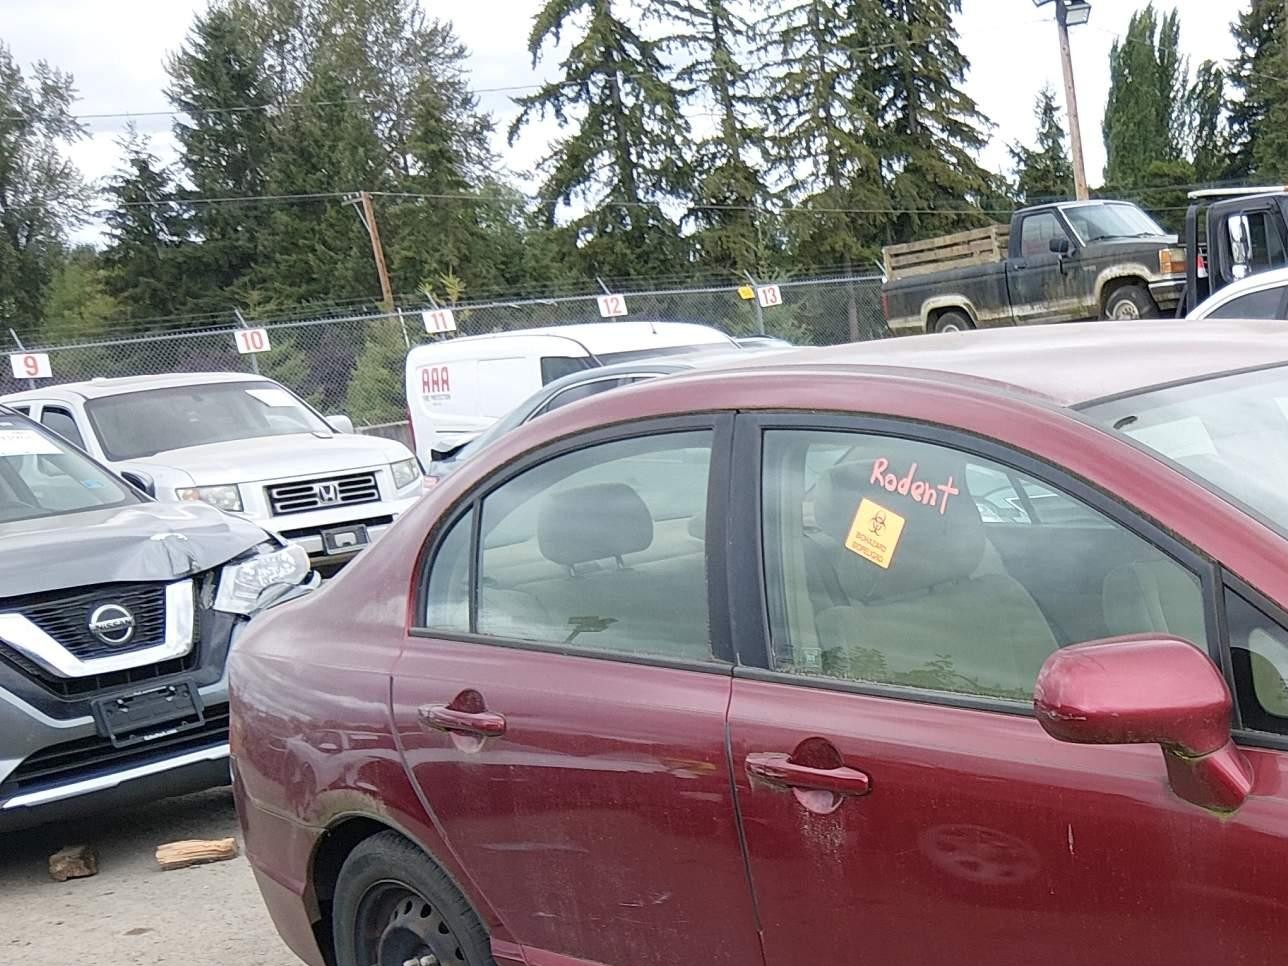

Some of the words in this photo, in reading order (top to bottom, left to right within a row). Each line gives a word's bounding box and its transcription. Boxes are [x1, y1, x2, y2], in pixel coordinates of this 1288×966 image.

[763, 287, 777, 304] 13
[603, 297, 622, 314] 12
[431, 312, 448, 330] 11
[241, 331, 263, 350] 10
[23, 355, 38, 376] 9
[422, 366, 450, 393] AAA
[870, 457, 959, 515] Rodent
[96, 618, 132, 632] NISSAN
